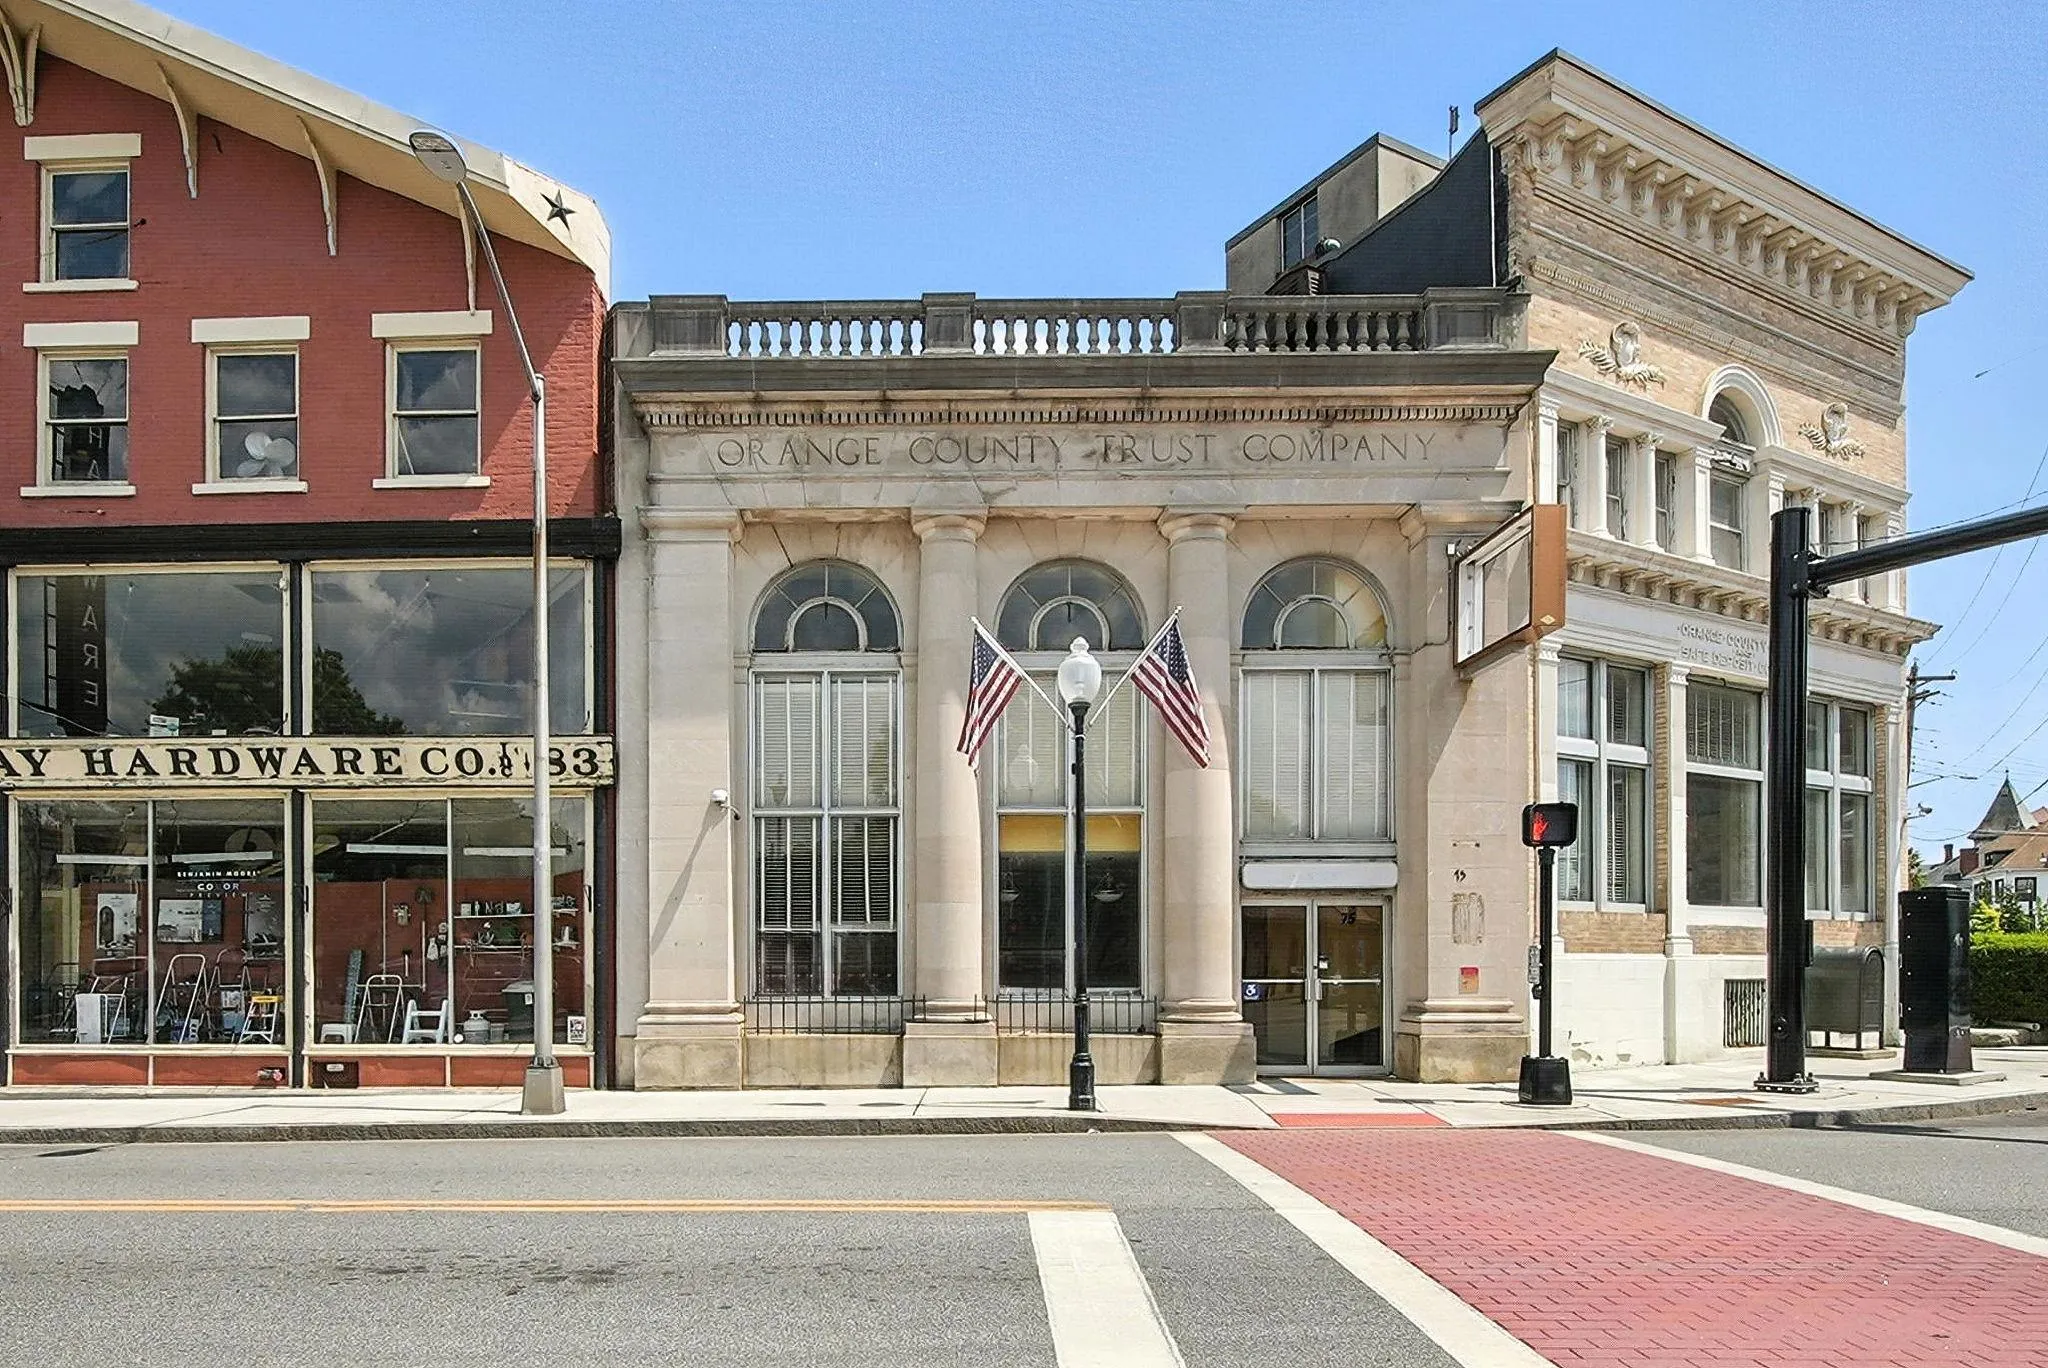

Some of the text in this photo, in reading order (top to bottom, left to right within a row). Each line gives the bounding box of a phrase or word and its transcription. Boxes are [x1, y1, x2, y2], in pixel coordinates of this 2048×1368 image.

[717, 432, 1437, 468] ORANGE COUNTY TRUST COMPANY
[82, 747, 403, 777] HARDWARE
[420, 747, 496, 776] CO.
